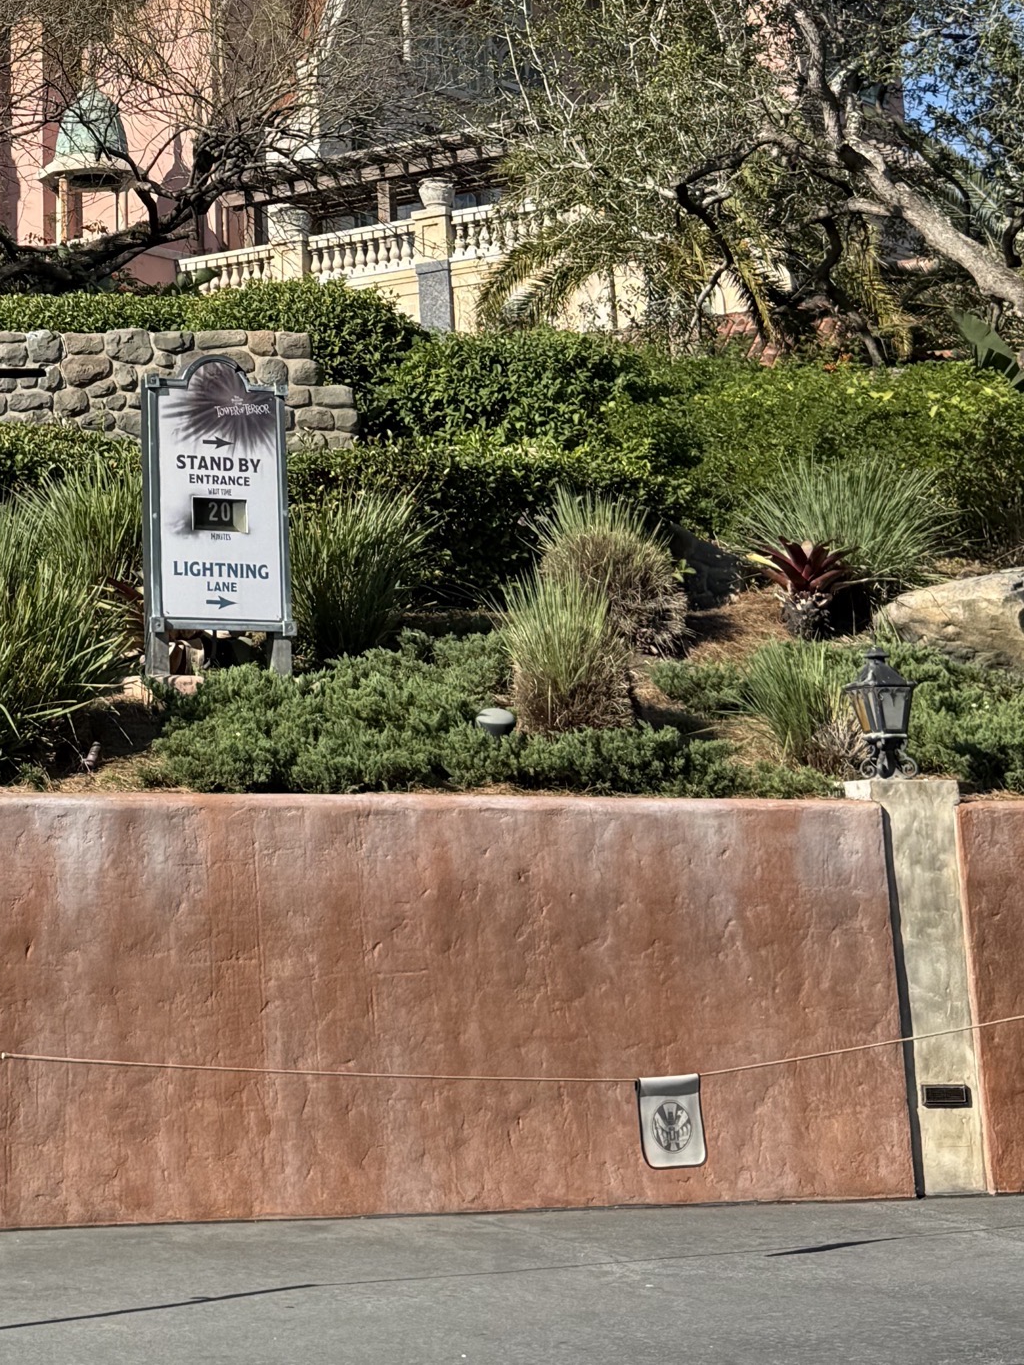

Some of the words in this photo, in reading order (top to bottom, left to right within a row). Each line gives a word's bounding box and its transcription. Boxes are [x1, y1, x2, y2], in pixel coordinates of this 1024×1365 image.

[243, 403, 271, 416] TERROR
[176, 454, 234, 472] STAND
[238, 457, 261, 473] BY
[189, 473, 251, 486] ENTRANCE
[208, 501, 231, 522] 20
[173, 560, 270, 580] LIGHTNING
[207, 581, 238, 593] LANE
